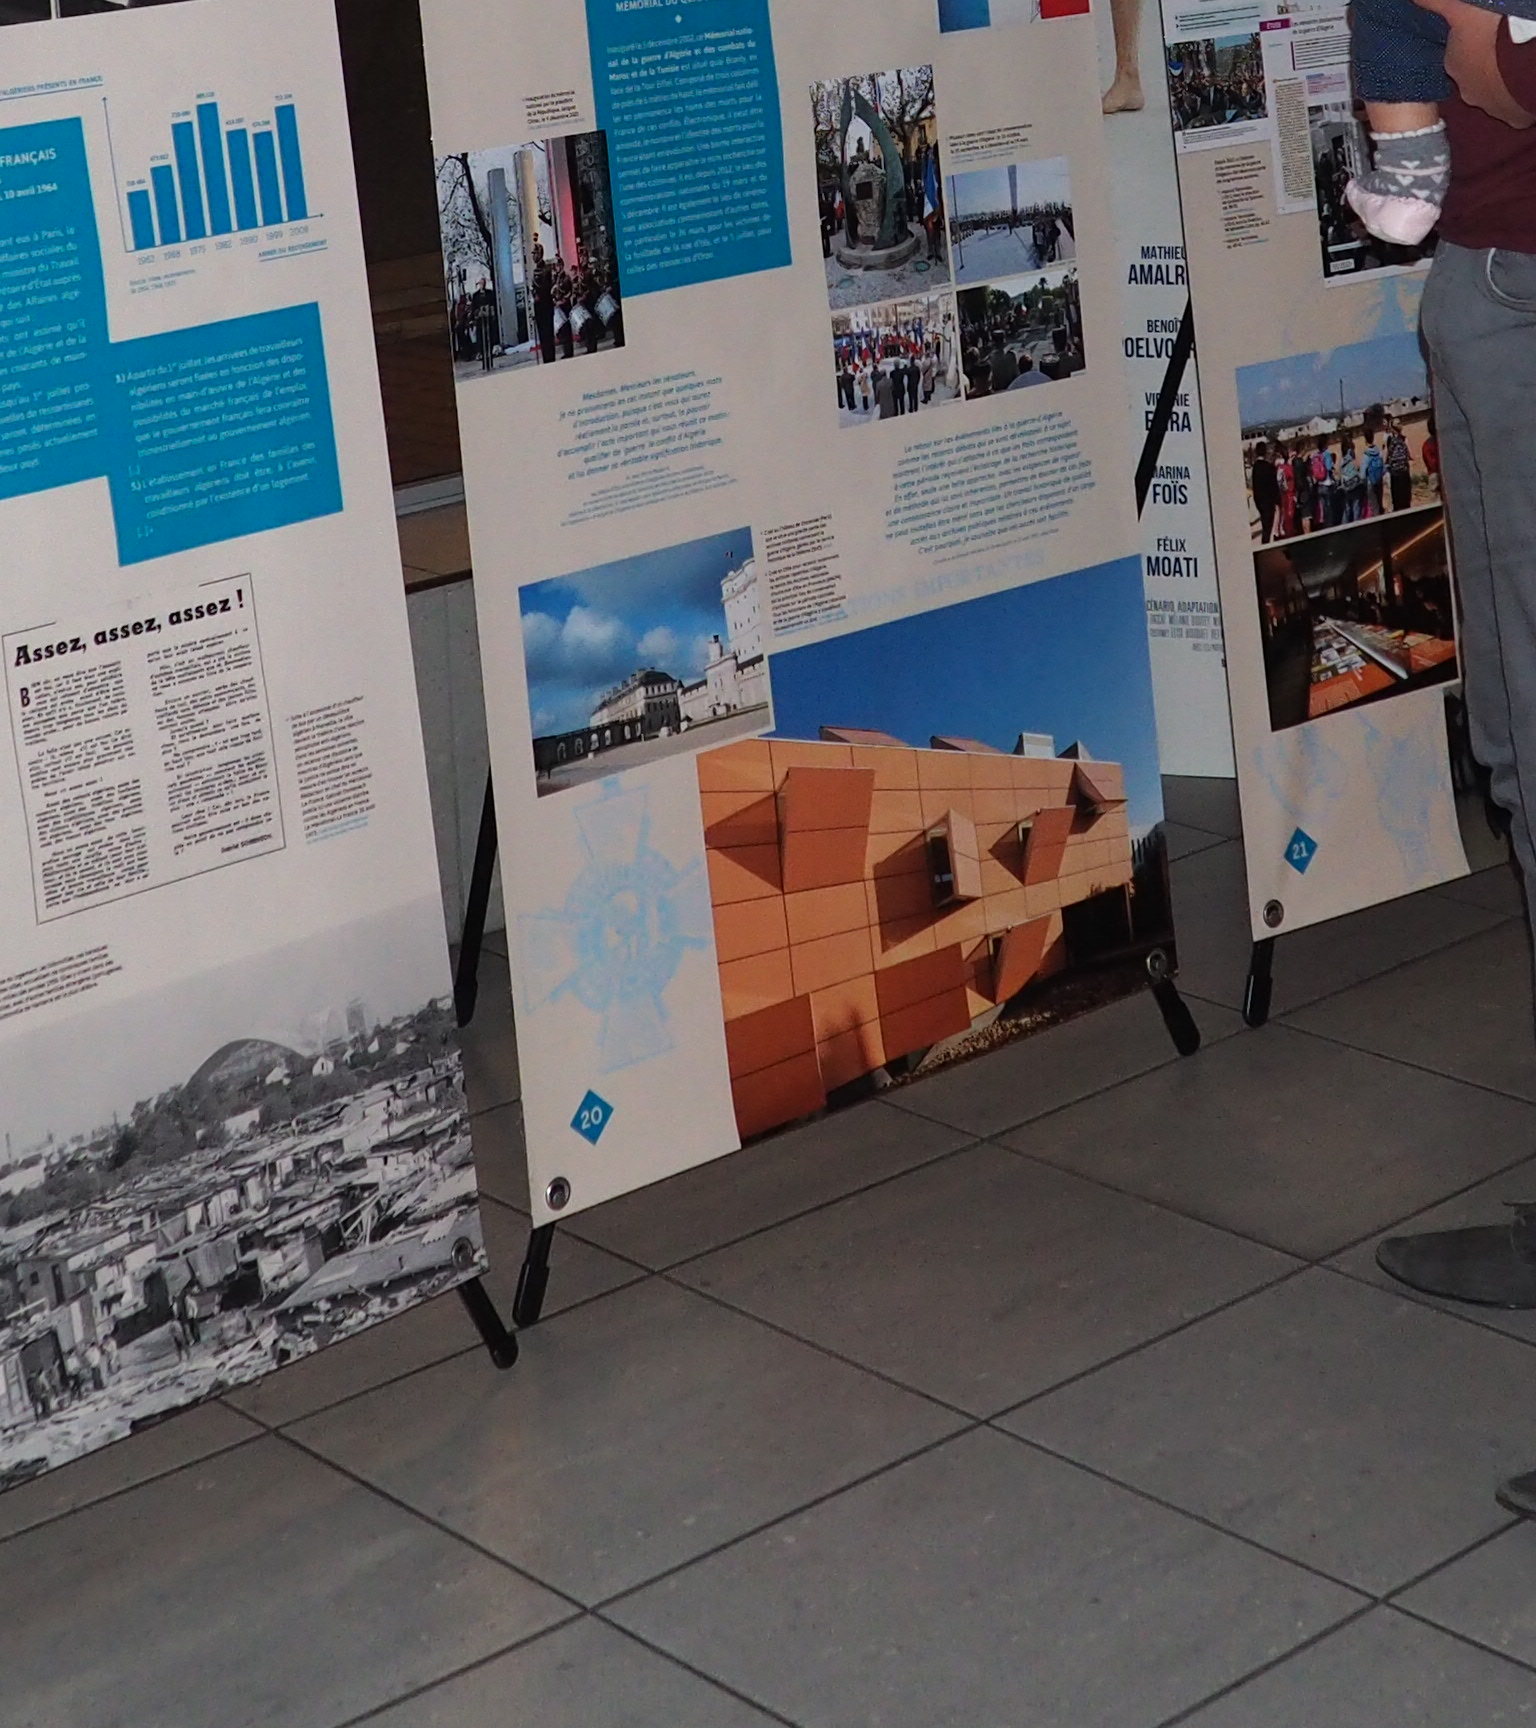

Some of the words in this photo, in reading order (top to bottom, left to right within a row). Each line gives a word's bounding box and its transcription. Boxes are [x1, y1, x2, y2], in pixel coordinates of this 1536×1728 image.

[16, 185, 35, 198] avril
[1152, 480, 1188, 505] FOÏS
[1156, 536, 1187, 553] FÉLIX
[1146, 556, 1198, 578] MOATI
[14, 636, 87, 668] Assez,
[93, 616, 162, 646] assez,
[168, 597, 231, 626] assez
[1292, 841, 1310, 860] 21
[580, 1104, 603, 1130] 20
